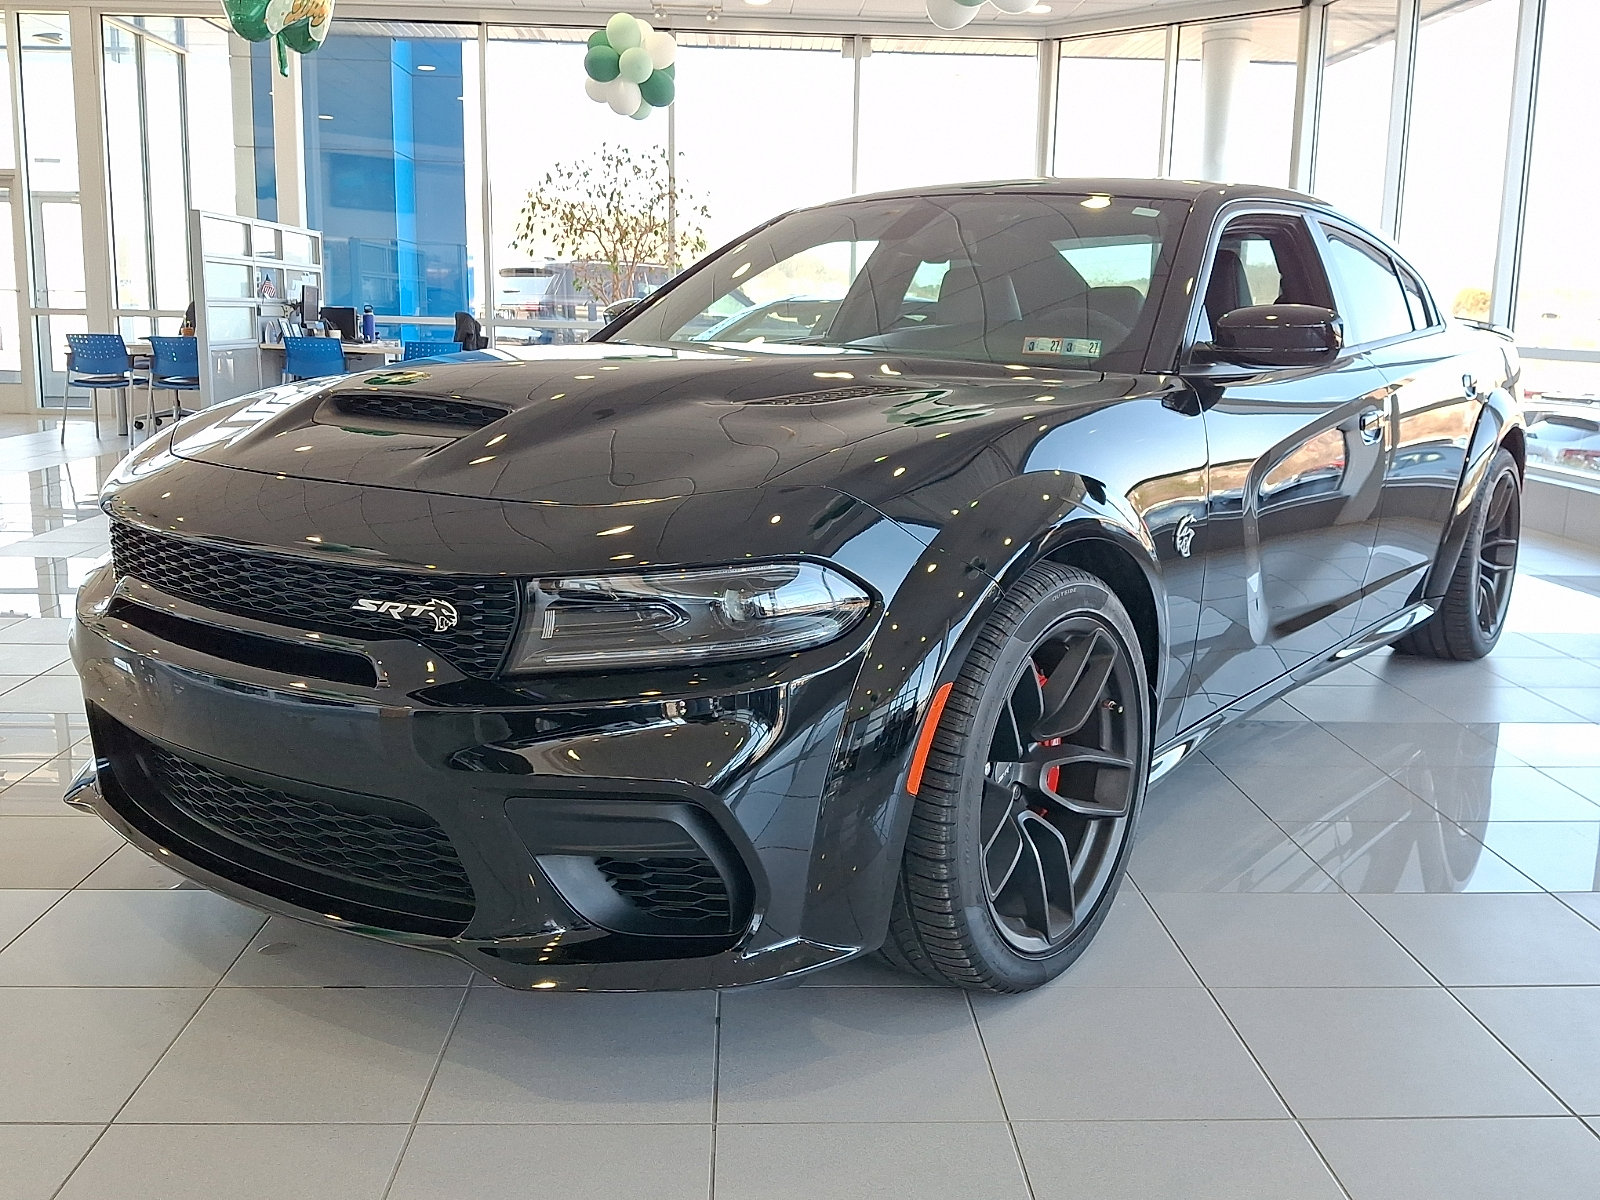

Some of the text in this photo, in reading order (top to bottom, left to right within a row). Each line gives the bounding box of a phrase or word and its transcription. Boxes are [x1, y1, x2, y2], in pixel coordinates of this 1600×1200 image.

[1028, 340, 1060, 352] 3 27
[1066, 342, 1099, 354] 3 27
[1052, 587, 1077, 602] OUTSIDE
[351, 598, 436, 620] SRT
